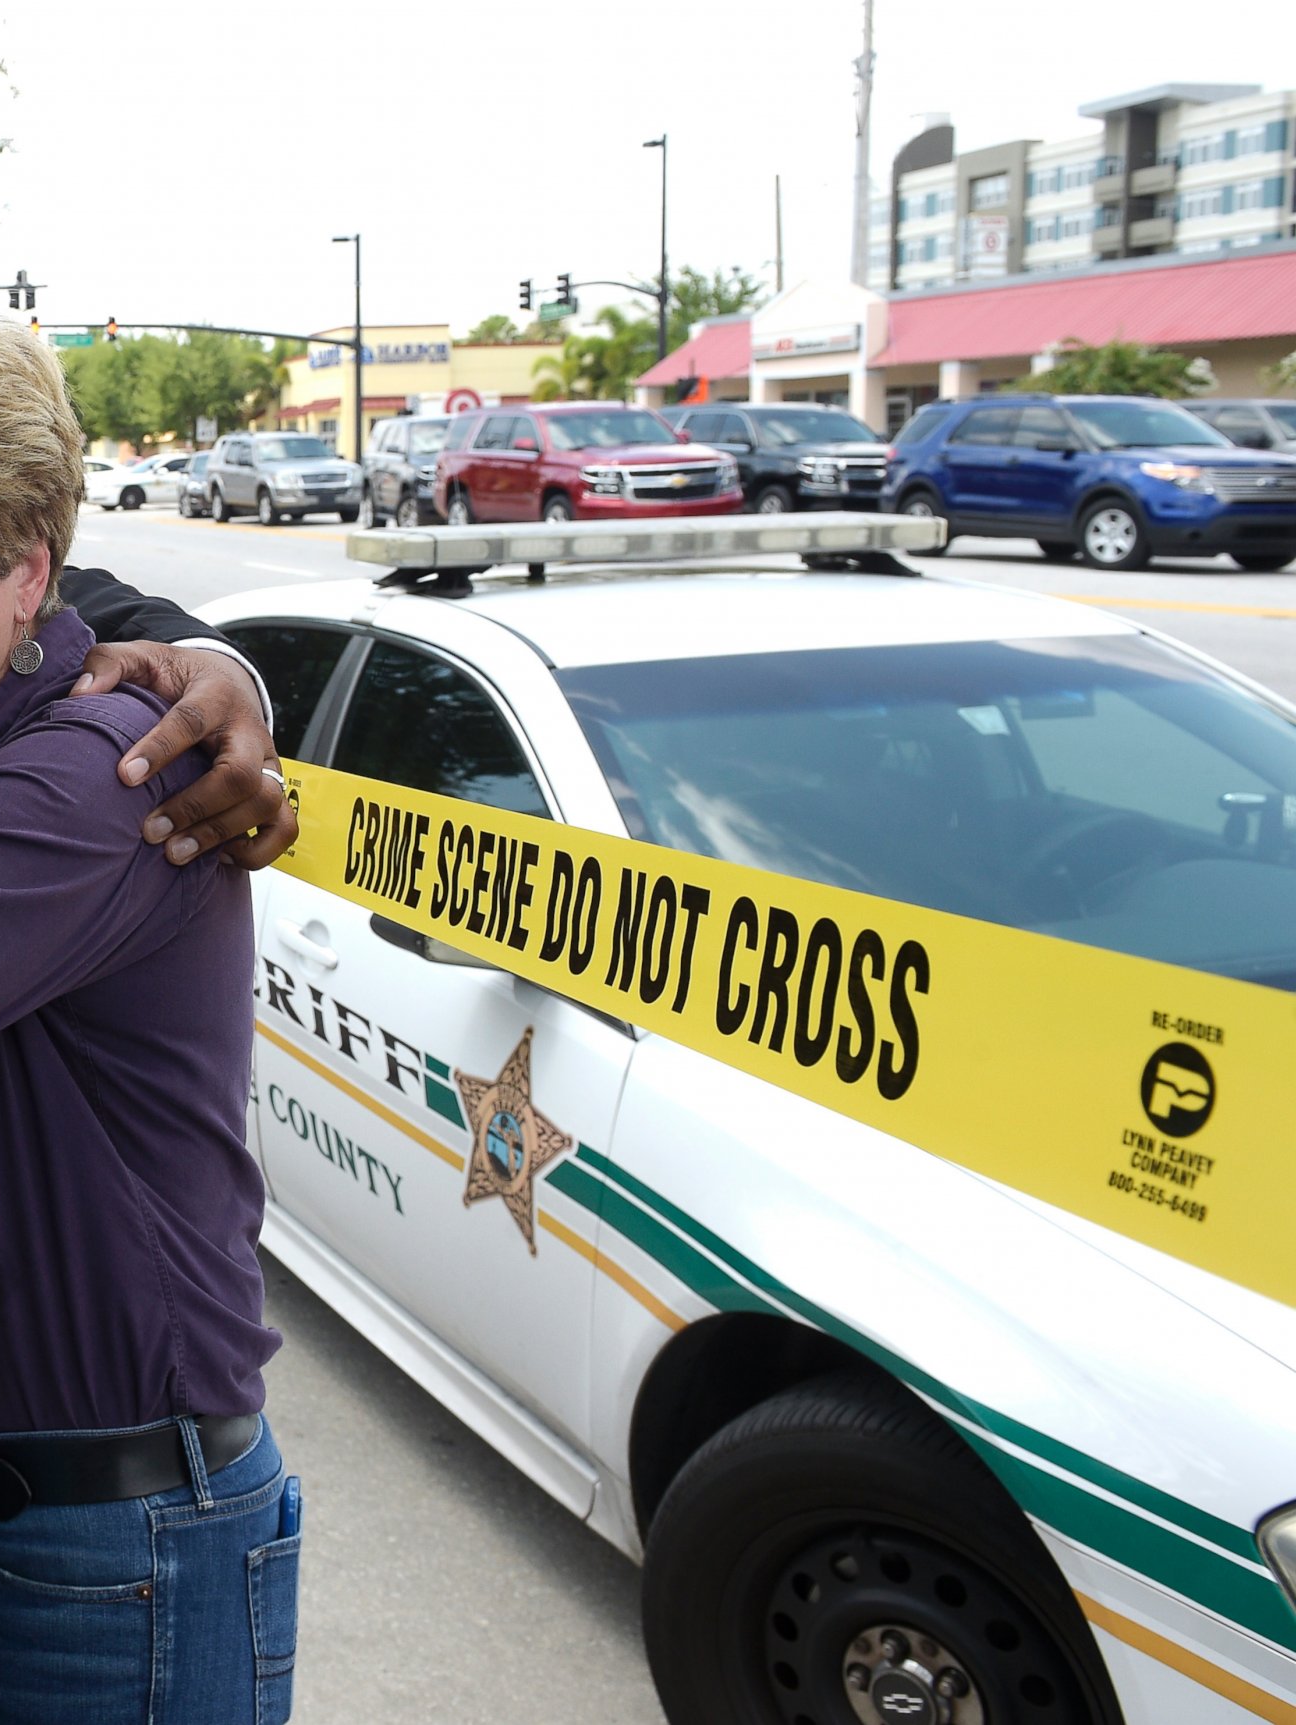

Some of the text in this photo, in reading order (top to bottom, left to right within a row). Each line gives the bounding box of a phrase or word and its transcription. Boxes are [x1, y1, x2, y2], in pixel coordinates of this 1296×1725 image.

[345, 797, 930, 1101] CRIME SCENE DO NOT CROSS
[254, 957, 422, 1096] RIFF
[1151, 1010, 1225, 1045] RE-ORDER
[269, 1082, 404, 1215] COUNTY
[1121, 1128, 1215, 1175] LYNN PEAVEY
[1130, 1151, 1198, 1189] COMPANY
